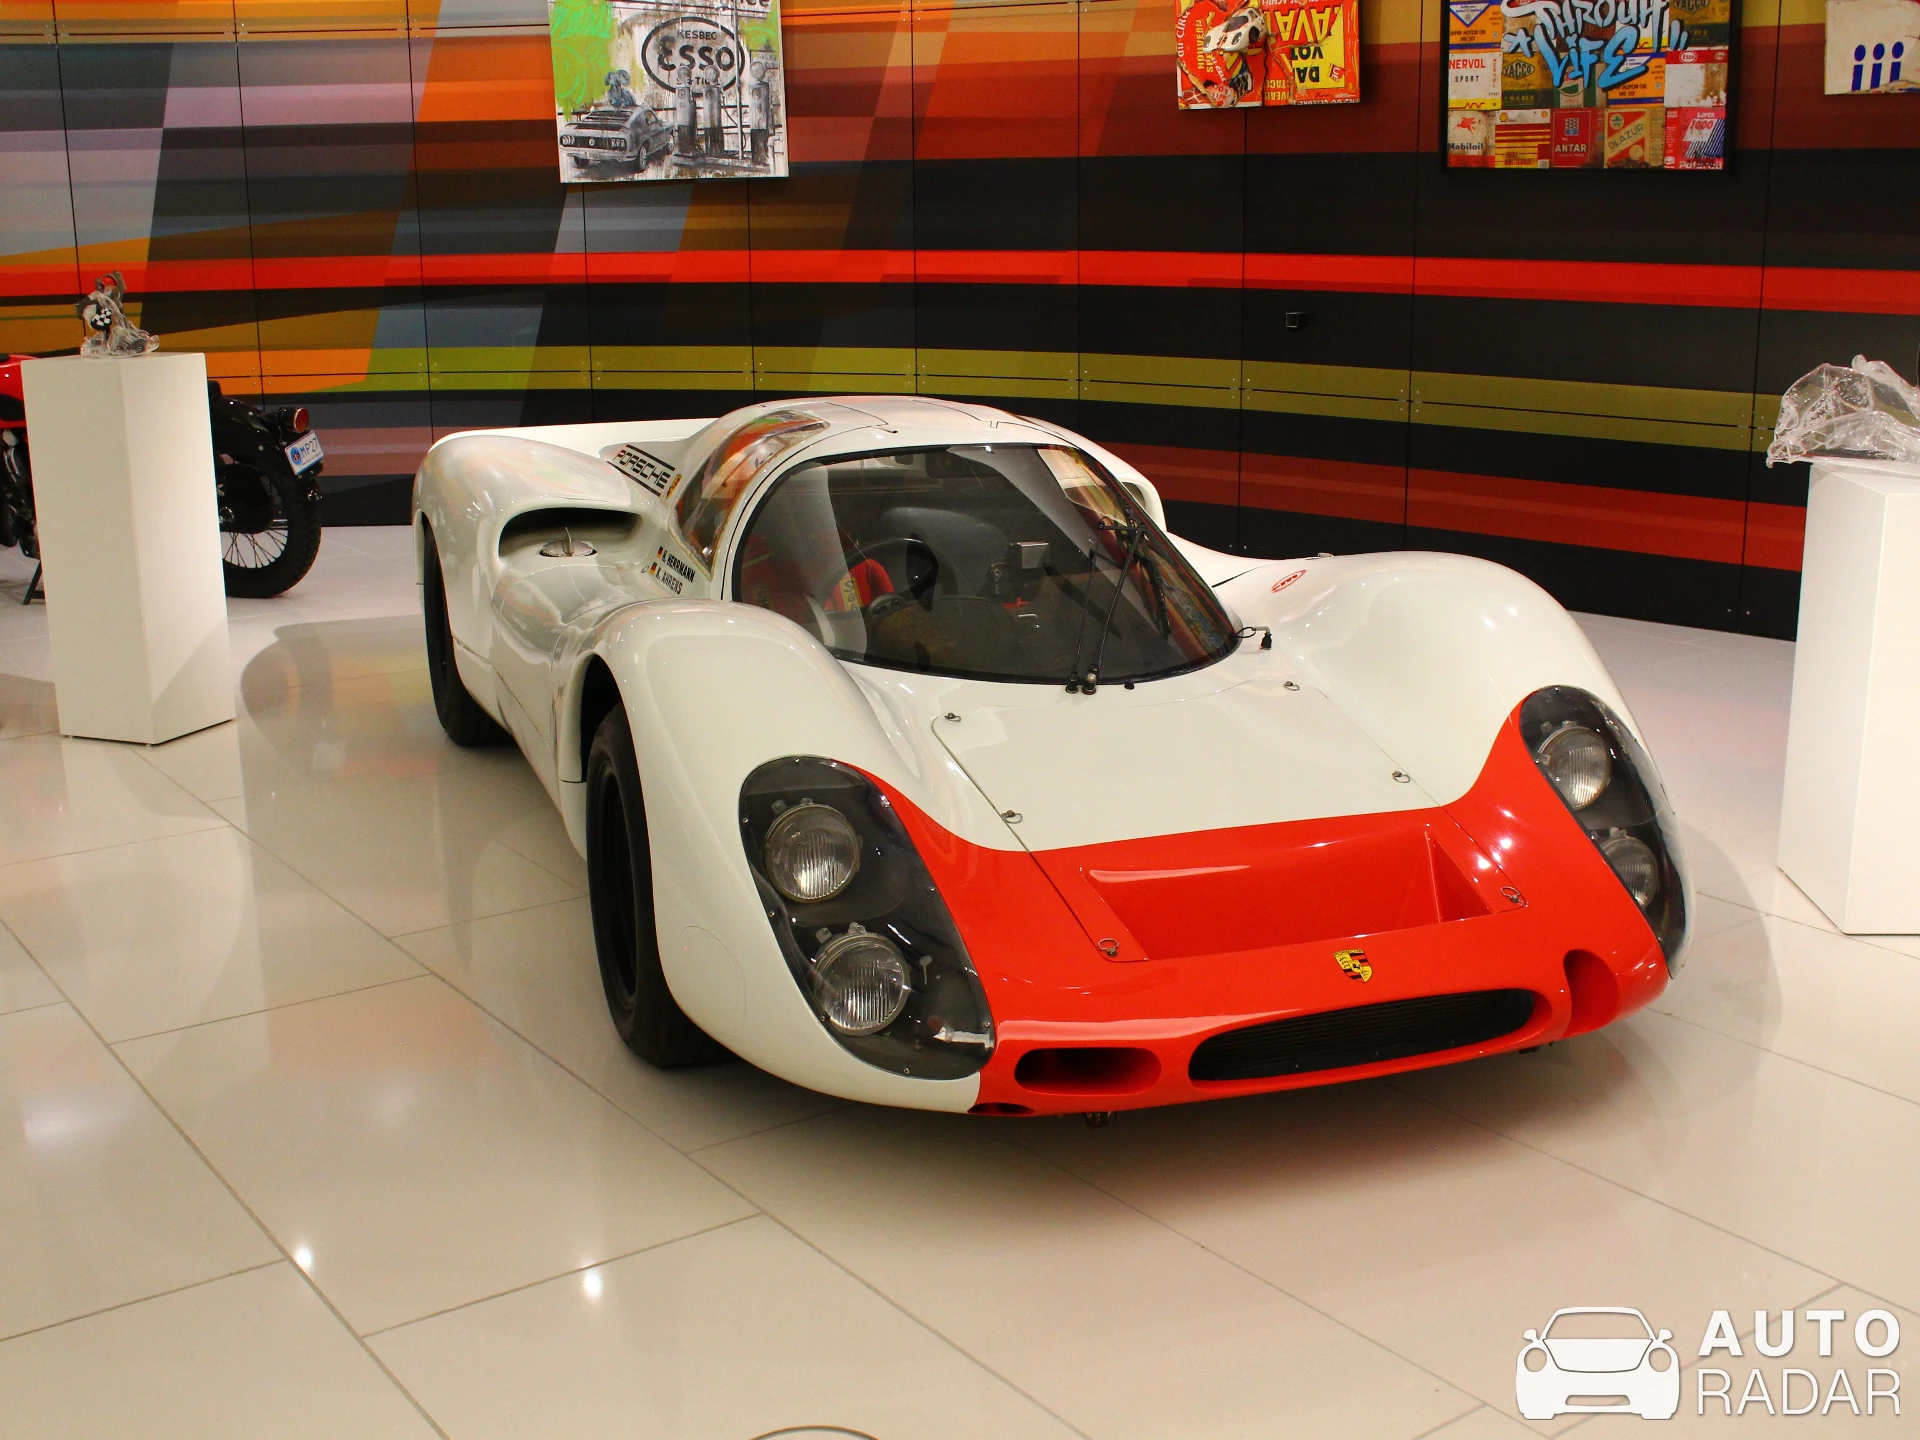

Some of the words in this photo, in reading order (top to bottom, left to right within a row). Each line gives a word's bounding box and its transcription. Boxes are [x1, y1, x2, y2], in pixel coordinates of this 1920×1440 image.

[677, 30, 717, 40] KESBEC
[1449, 59, 1486, 69] NERVOL
[1503, 62, 1532, 78] YACCO
[1555, 144, 1587, 152] ANTAR
[613, 450, 671, 489] PORSCHE
